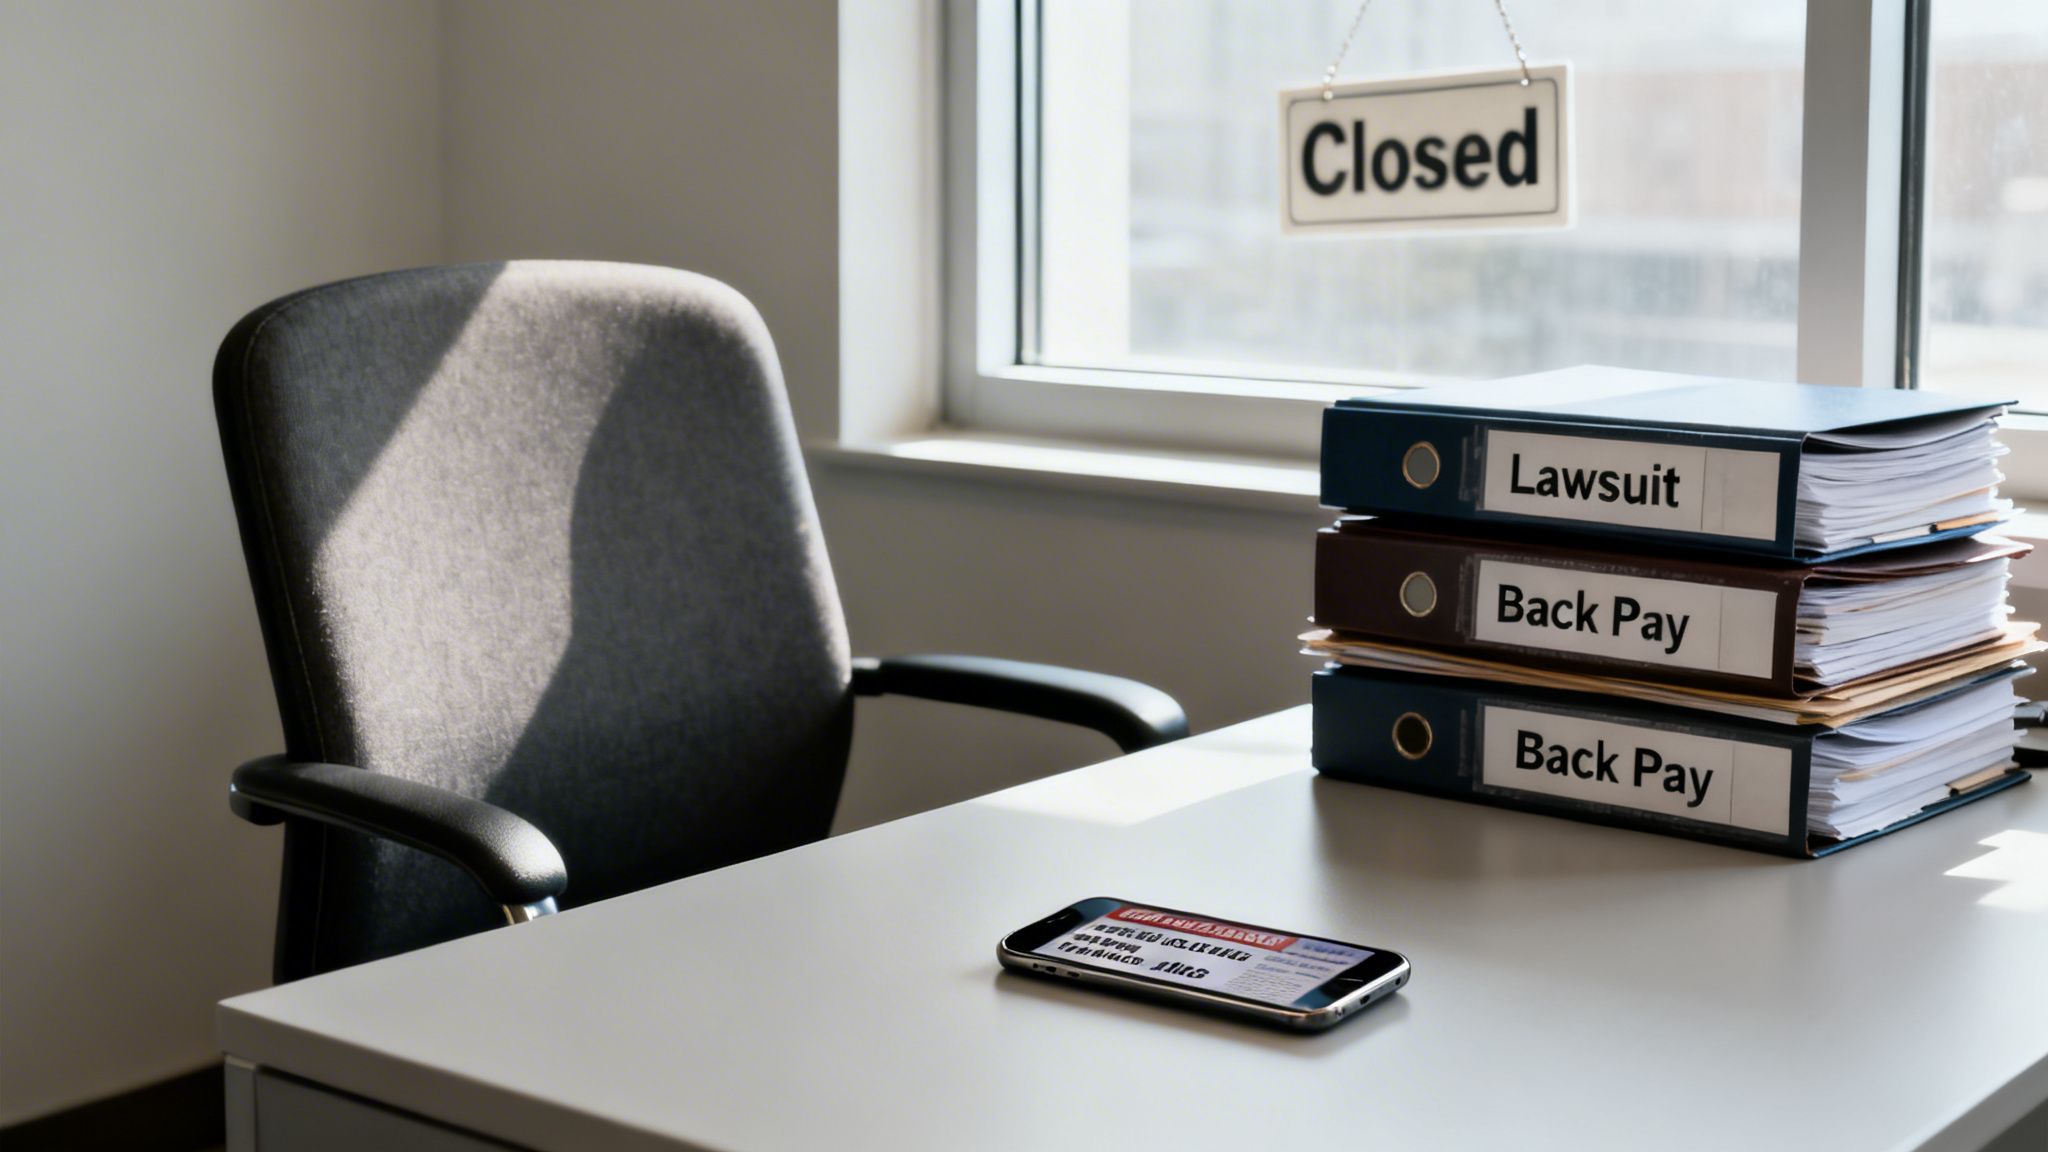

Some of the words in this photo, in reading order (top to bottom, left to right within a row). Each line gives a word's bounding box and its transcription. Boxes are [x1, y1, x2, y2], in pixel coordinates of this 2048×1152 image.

[1301, 106, 1539, 197] Closed
[1509, 452, 1681, 509] Lawsuit
[1497, 583, 1599, 634] Back
[1611, 595, 1690, 655] Pay
[1515, 729, 1620, 785] Back
[1633, 746, 1714, 809] Pay
